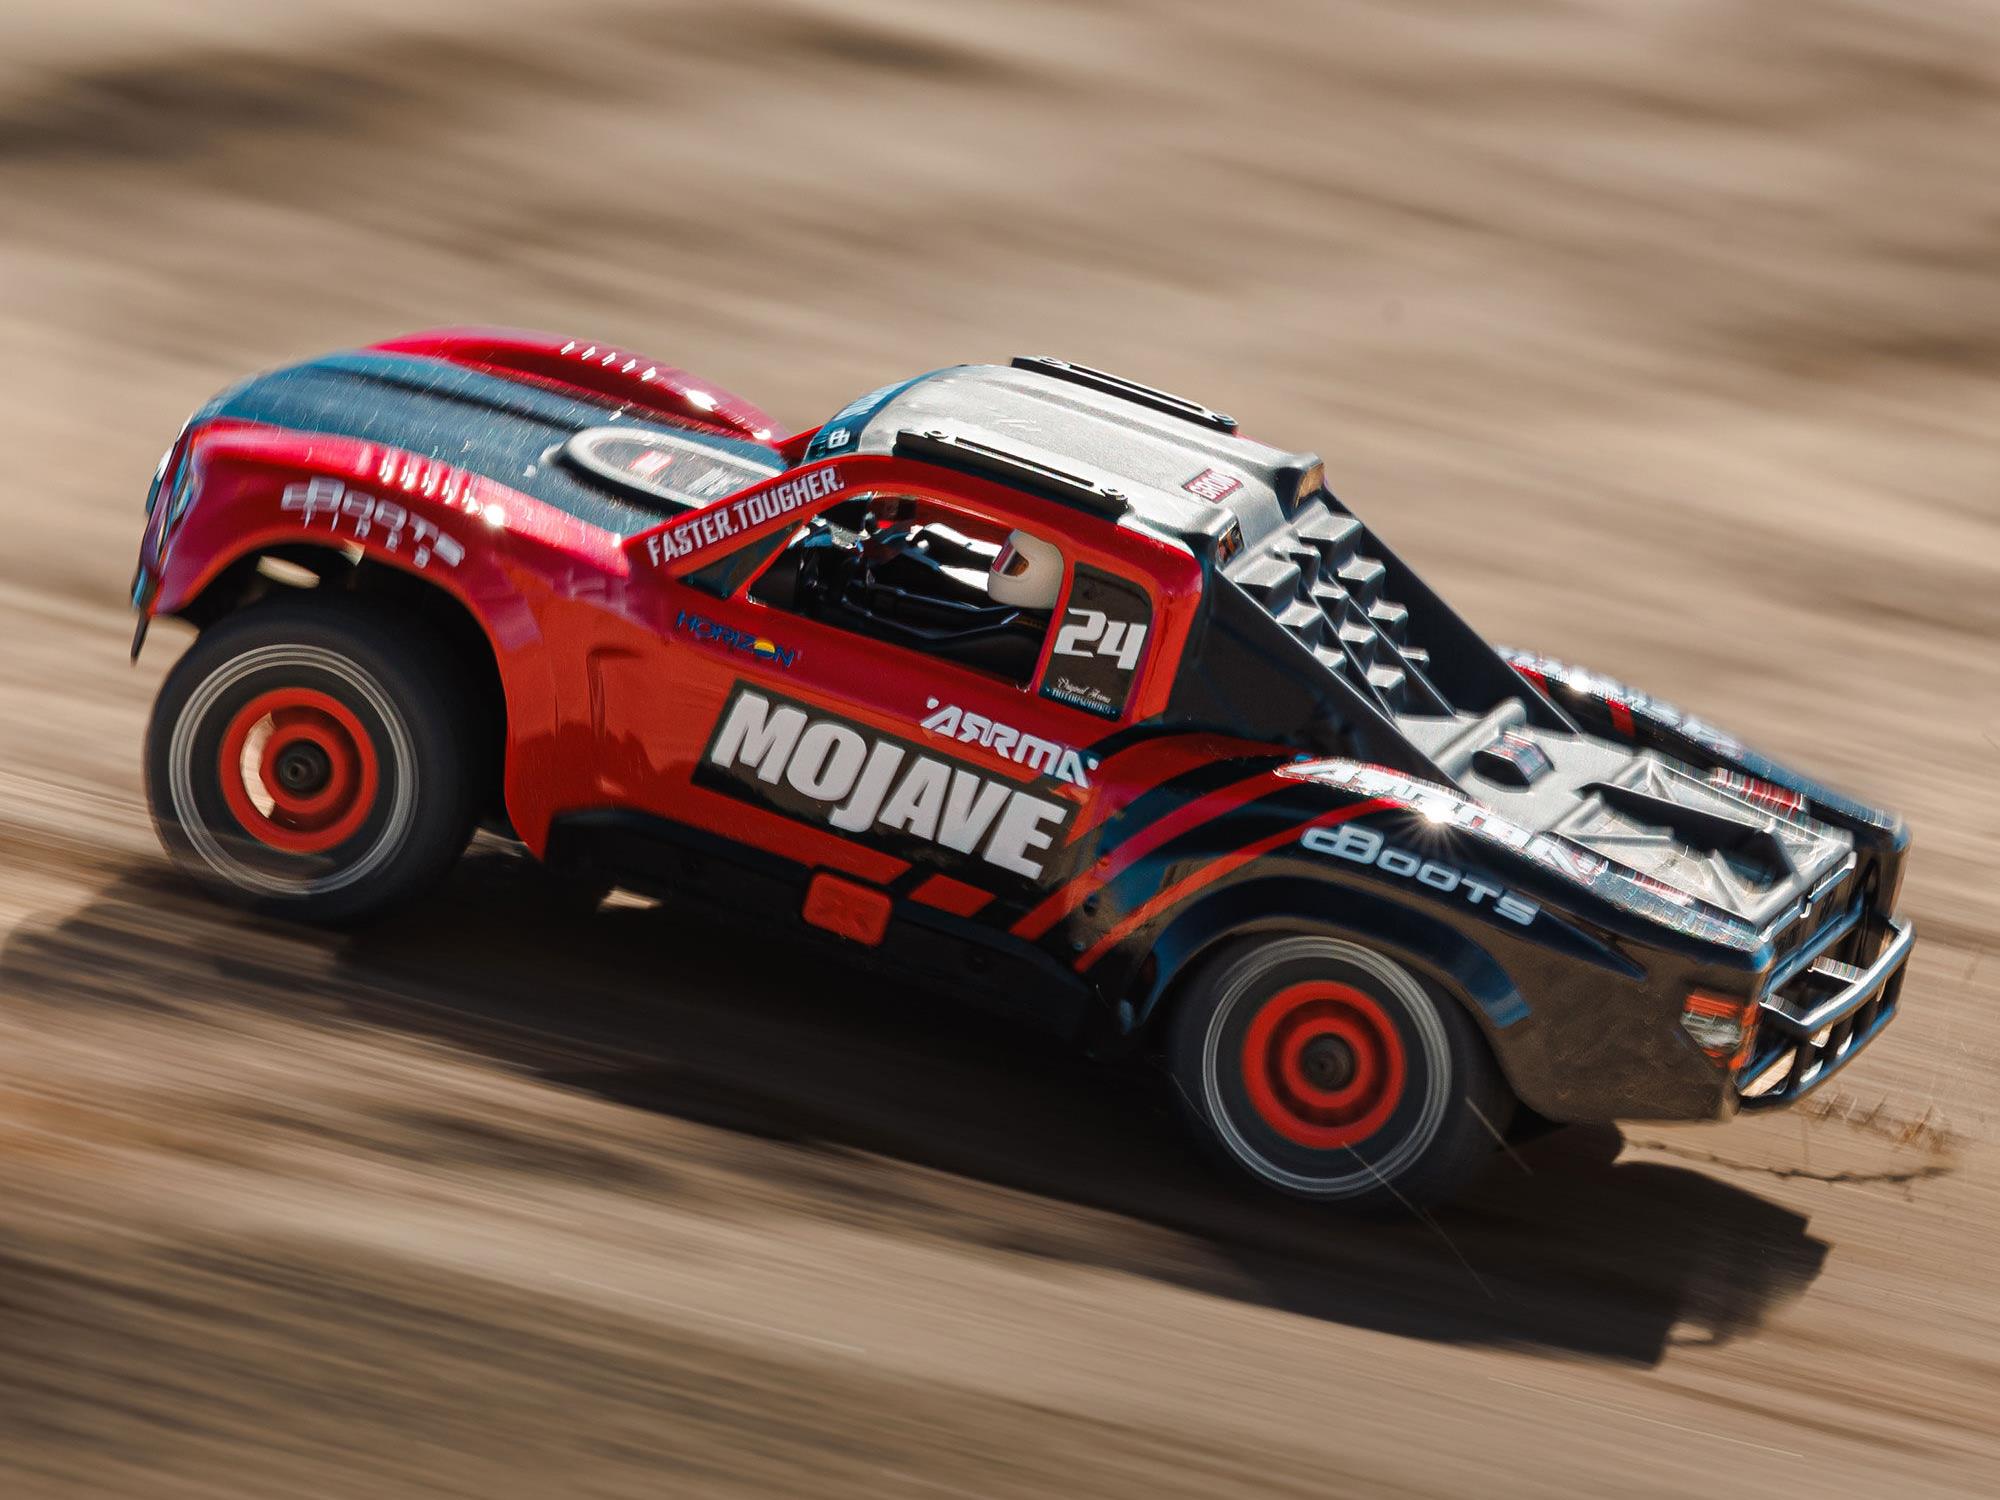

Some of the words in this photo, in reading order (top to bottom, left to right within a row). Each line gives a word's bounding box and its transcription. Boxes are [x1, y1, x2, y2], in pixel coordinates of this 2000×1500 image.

[1054, 608, 1148, 670] 24
[711, 690, 1067, 880] MOJAVE
[920, 697, 1099, 788] ARRMA
